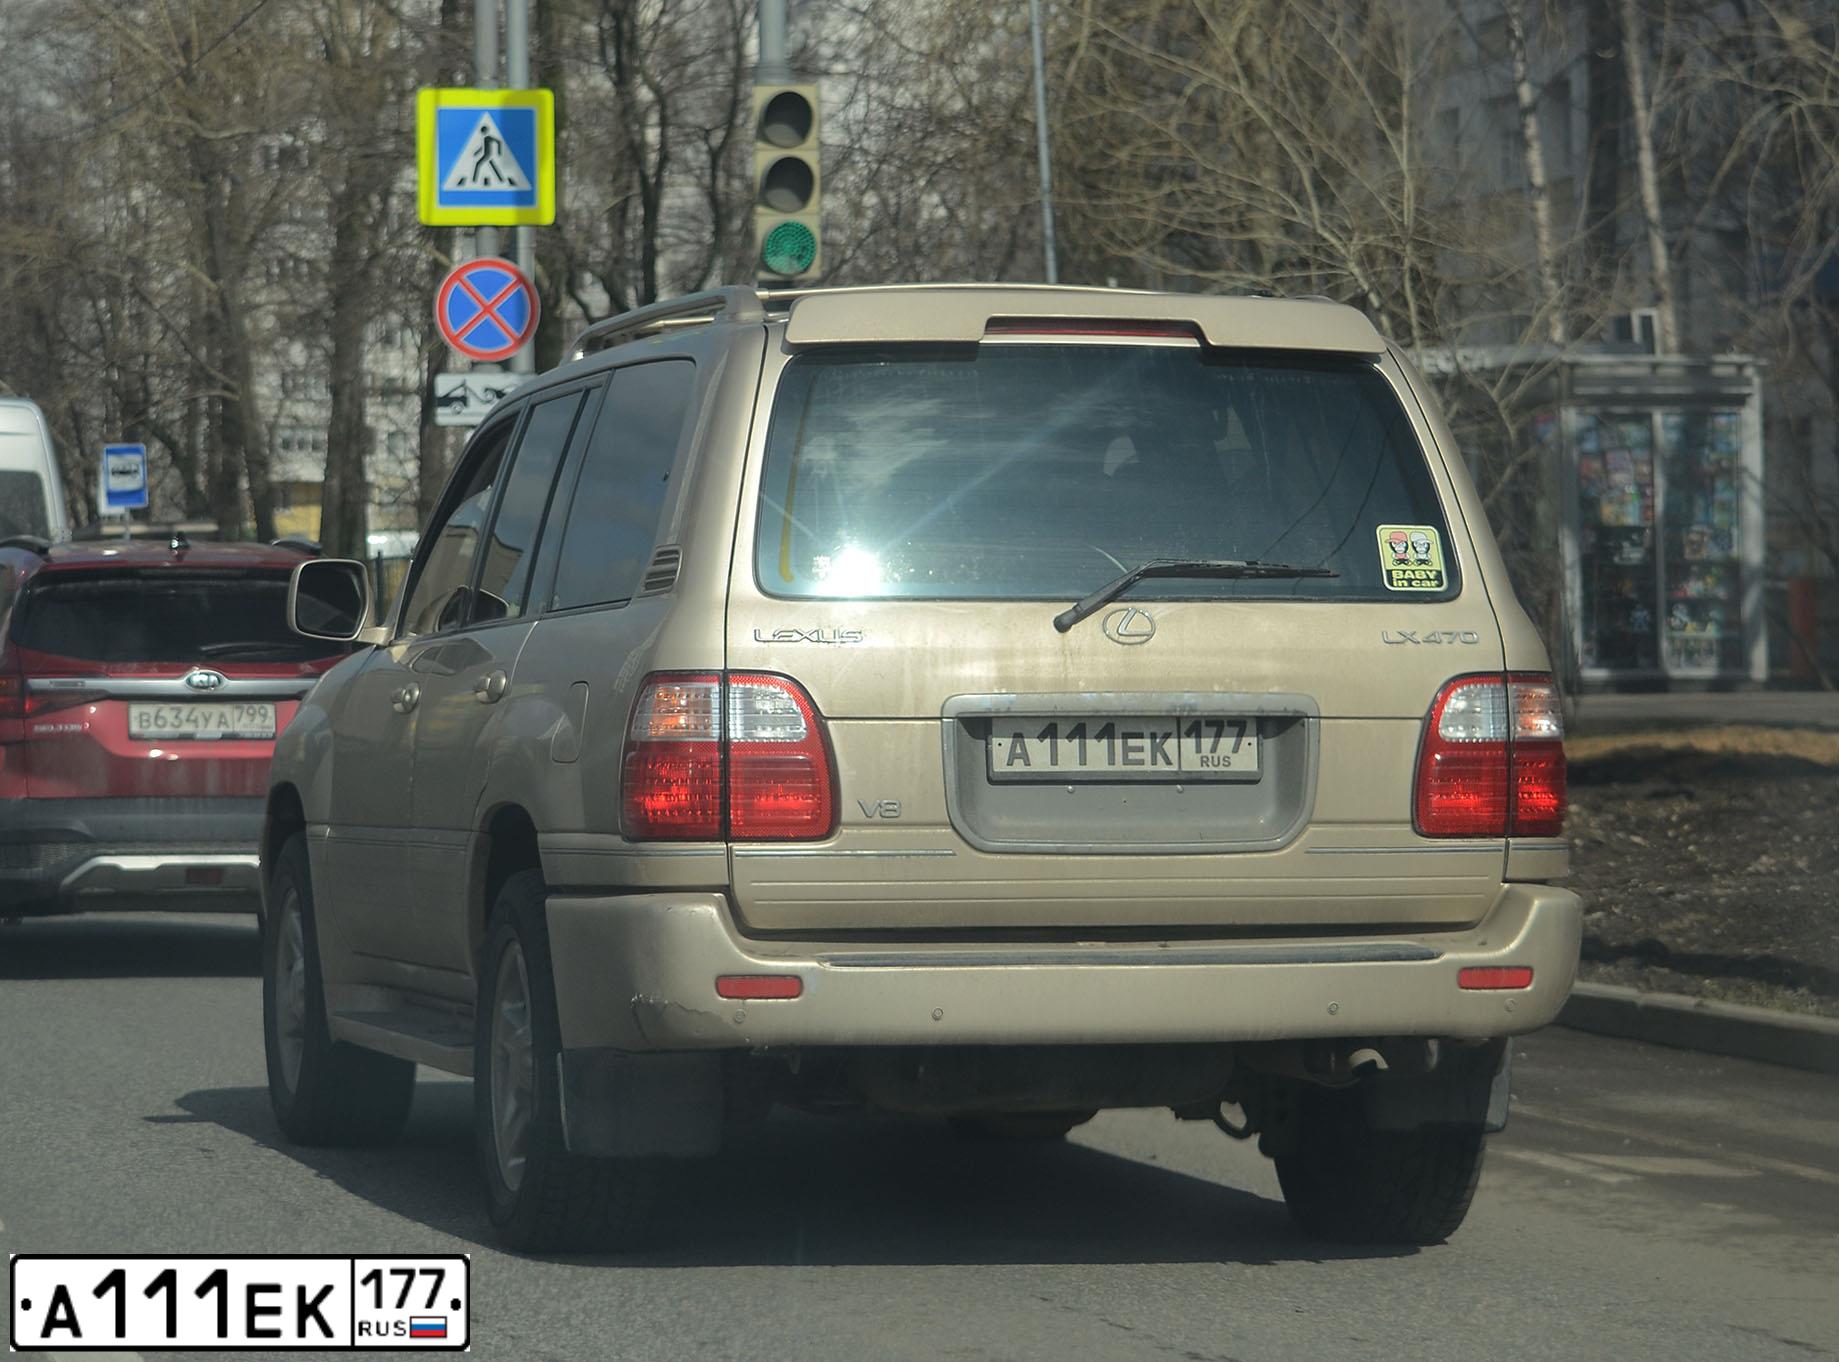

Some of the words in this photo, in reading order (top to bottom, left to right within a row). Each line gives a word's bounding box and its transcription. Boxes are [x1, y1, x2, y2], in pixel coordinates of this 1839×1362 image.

[1391, 570, 1437, 579] BABY
[1392, 579, 1408, 587] in
[1411, 580, 1439, 588] car
[754, 629, 863, 643] LEXUS
[234, 705, 269, 723] 799
[1184, 720, 1247, 754] 177
[1200, 755, 1232, 767] RUS
[857, 799, 902, 819] V8
